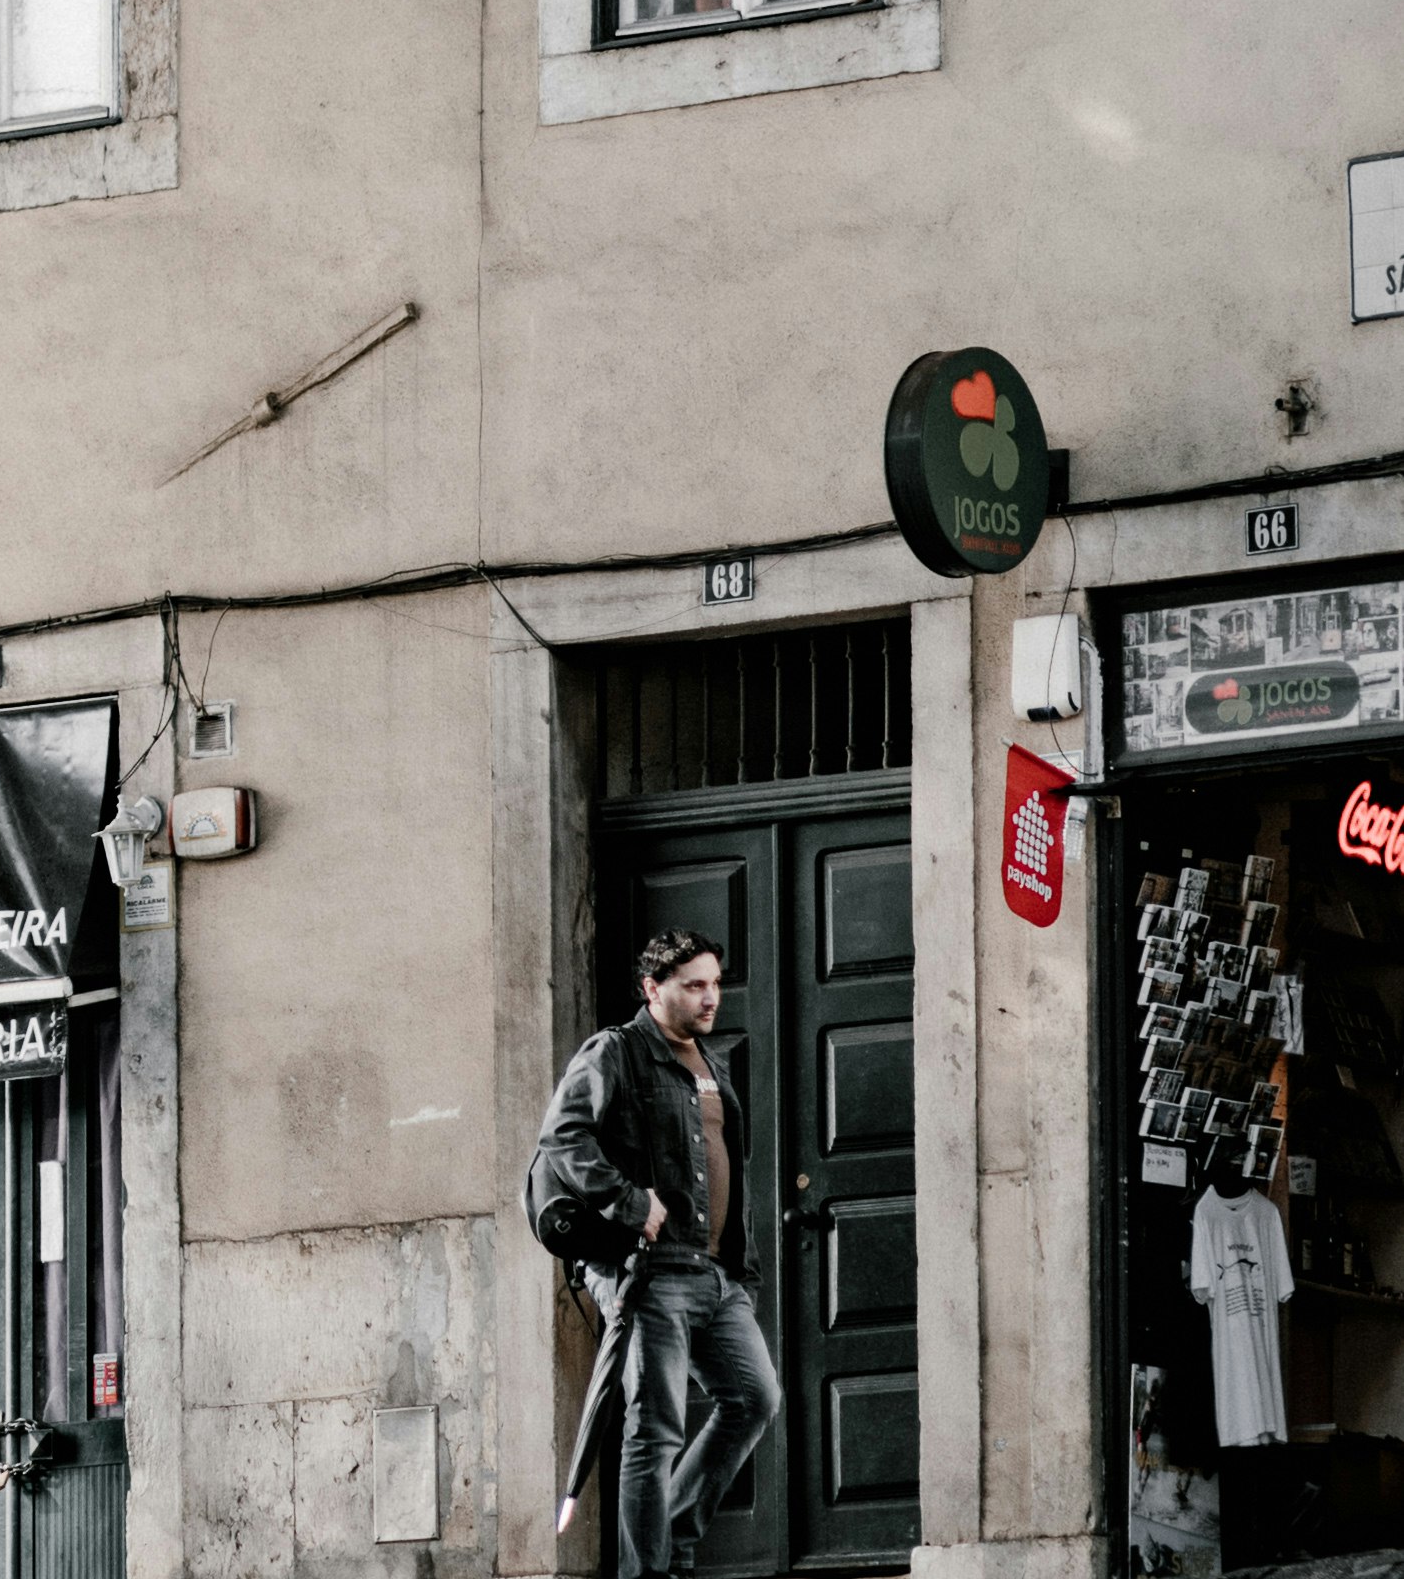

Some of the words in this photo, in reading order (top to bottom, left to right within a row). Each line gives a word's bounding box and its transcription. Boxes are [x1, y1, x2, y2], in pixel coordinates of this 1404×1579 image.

[954, 495, 1021, 539] JOGOS
[1254, 510, 1287, 550] 66
[712, 561, 744, 599] 68
[1258, 675, 1332, 716] JOGOS
[1006, 864, 1053, 903] payshop
